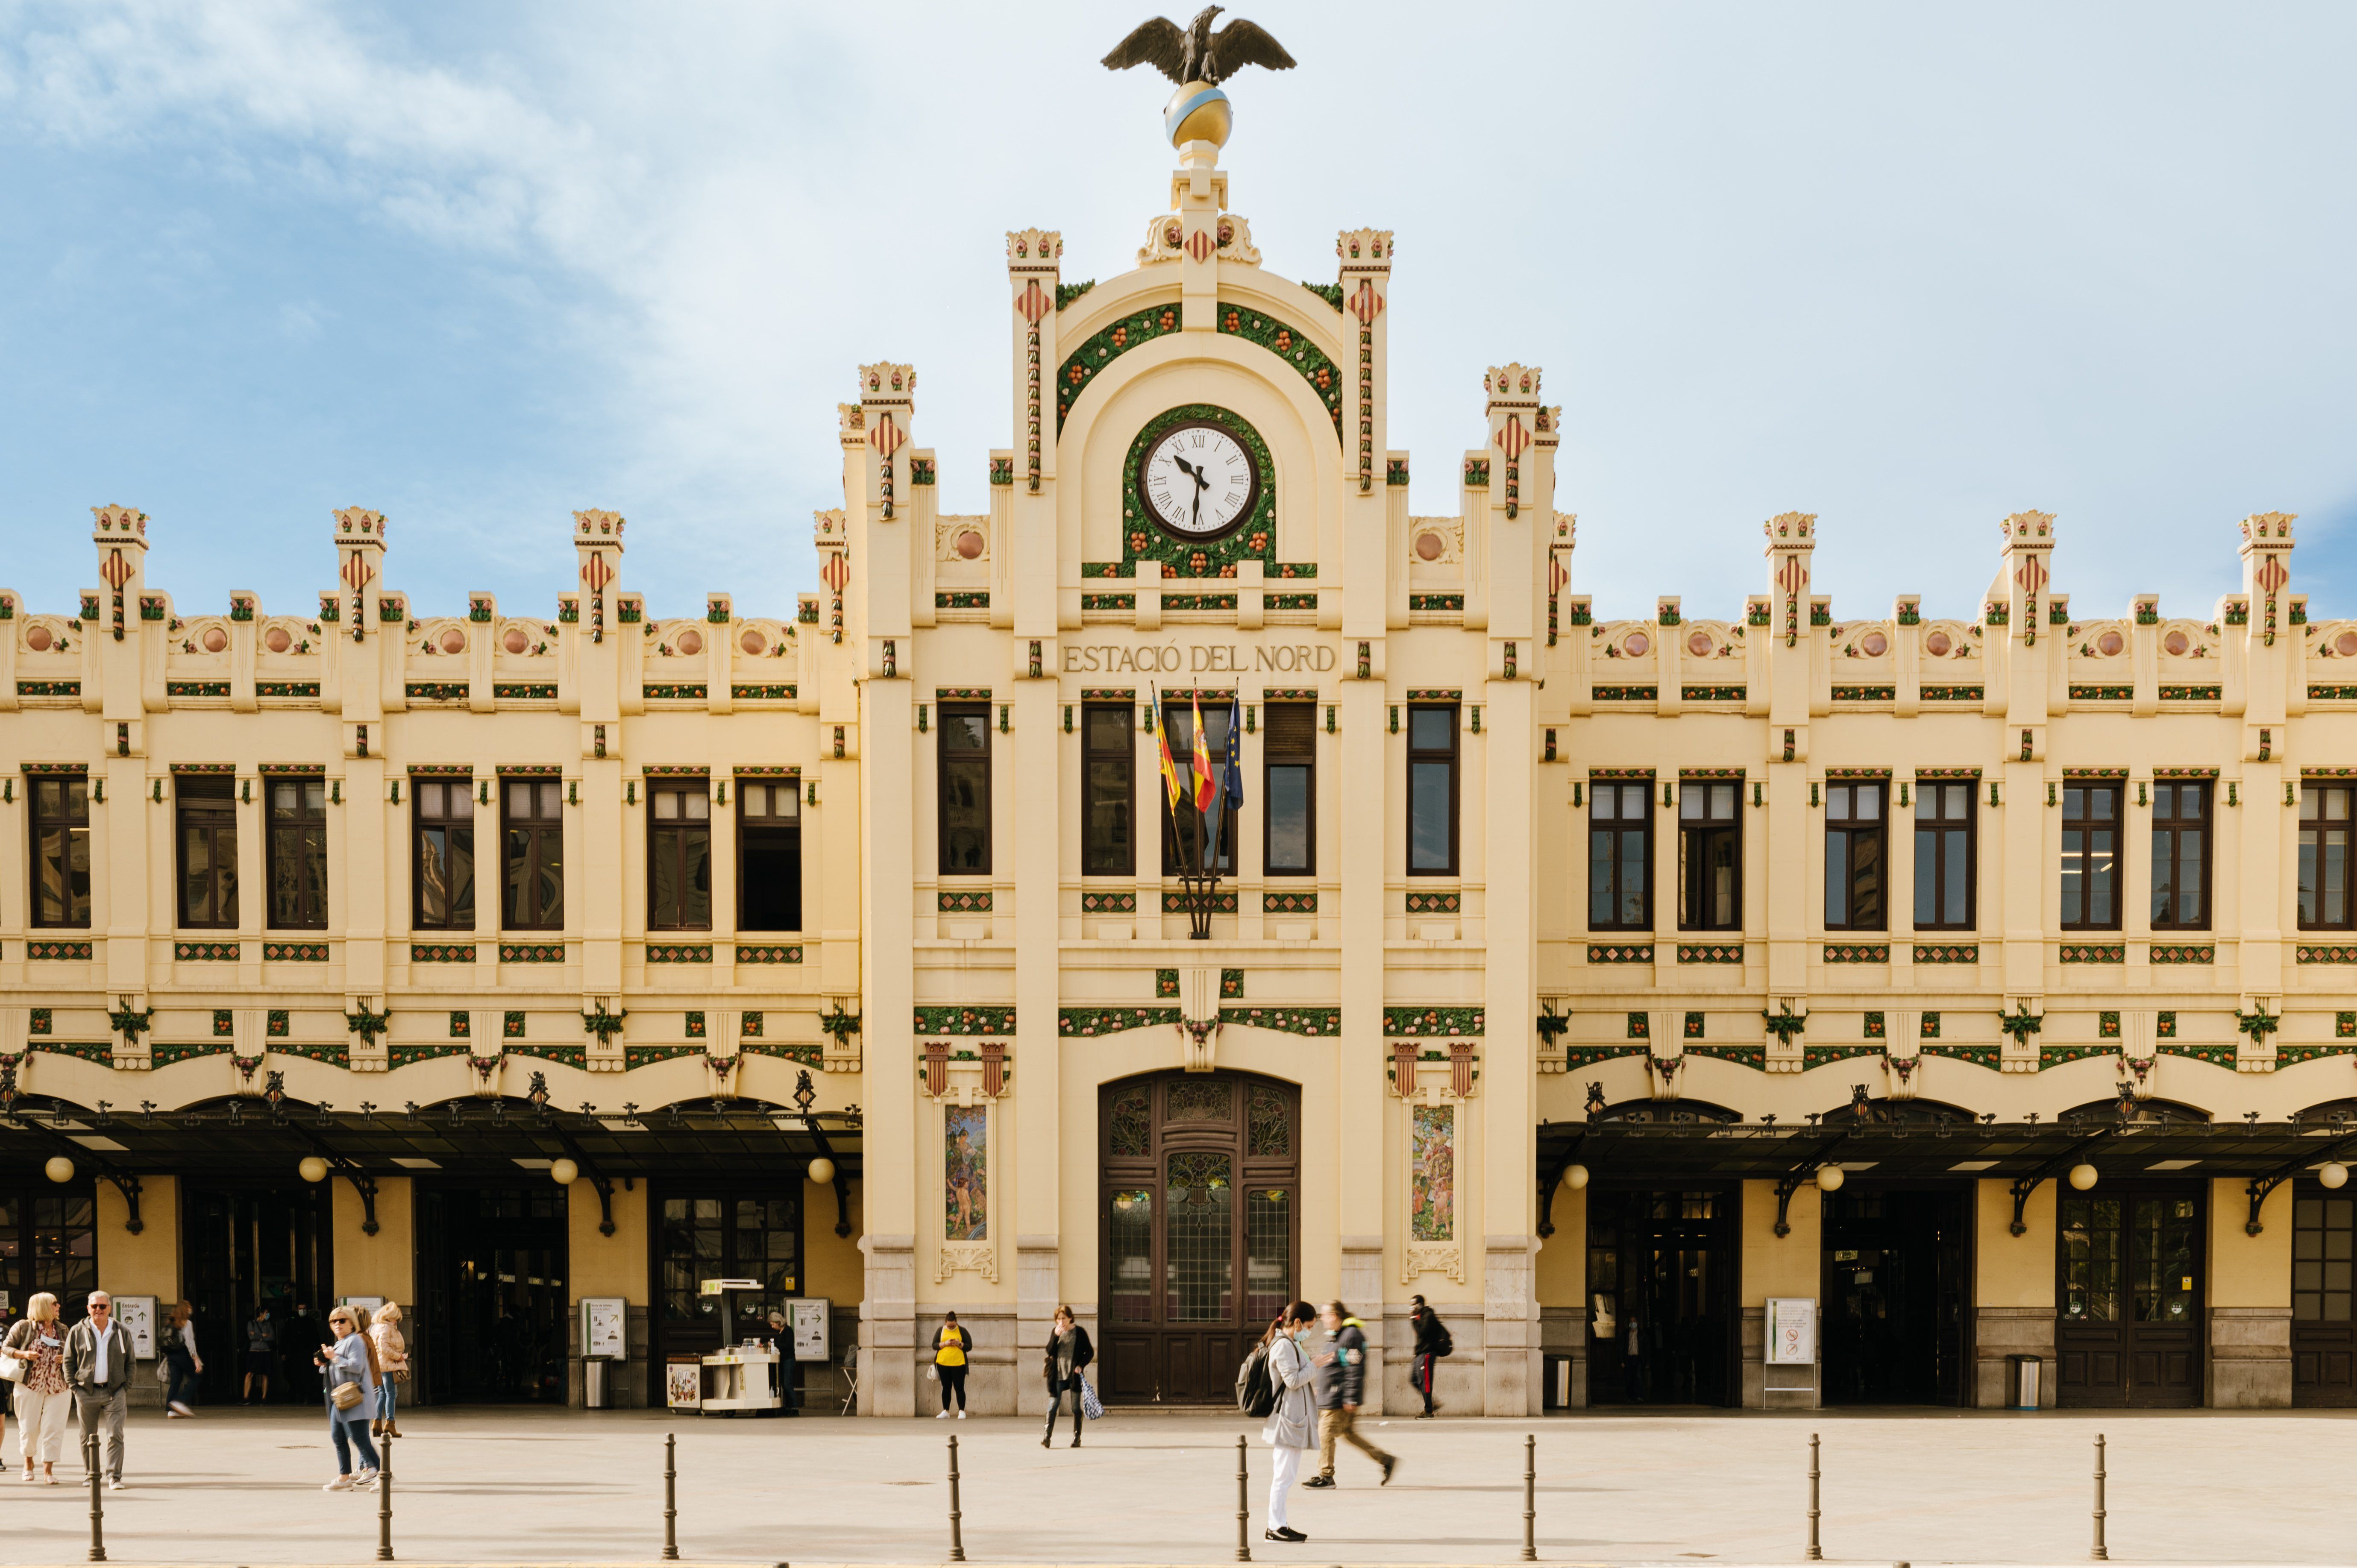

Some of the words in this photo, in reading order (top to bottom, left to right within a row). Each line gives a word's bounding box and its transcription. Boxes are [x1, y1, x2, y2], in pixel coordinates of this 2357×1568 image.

[1171, 439, 1185, 455] XI
[1192, 435, 1205, 448] XII
[1214, 440, 1221, 452] I
[1158, 456, 1171, 467] X
[1226, 455, 1238, 466] II
[1154, 475, 1166, 486] IX
[1231, 475, 1244, 484] III
[1157, 491, 1173, 510] VIII
[1224, 492, 1240, 507] IIII
[1172, 506, 1186, 522] VII
[1215, 508, 1224, 520] V
[1063, 638, 1181, 672] ESTACIÓ
[1189, 645, 1248, 672] DEL
[1255, 645, 1336, 672] NORD
